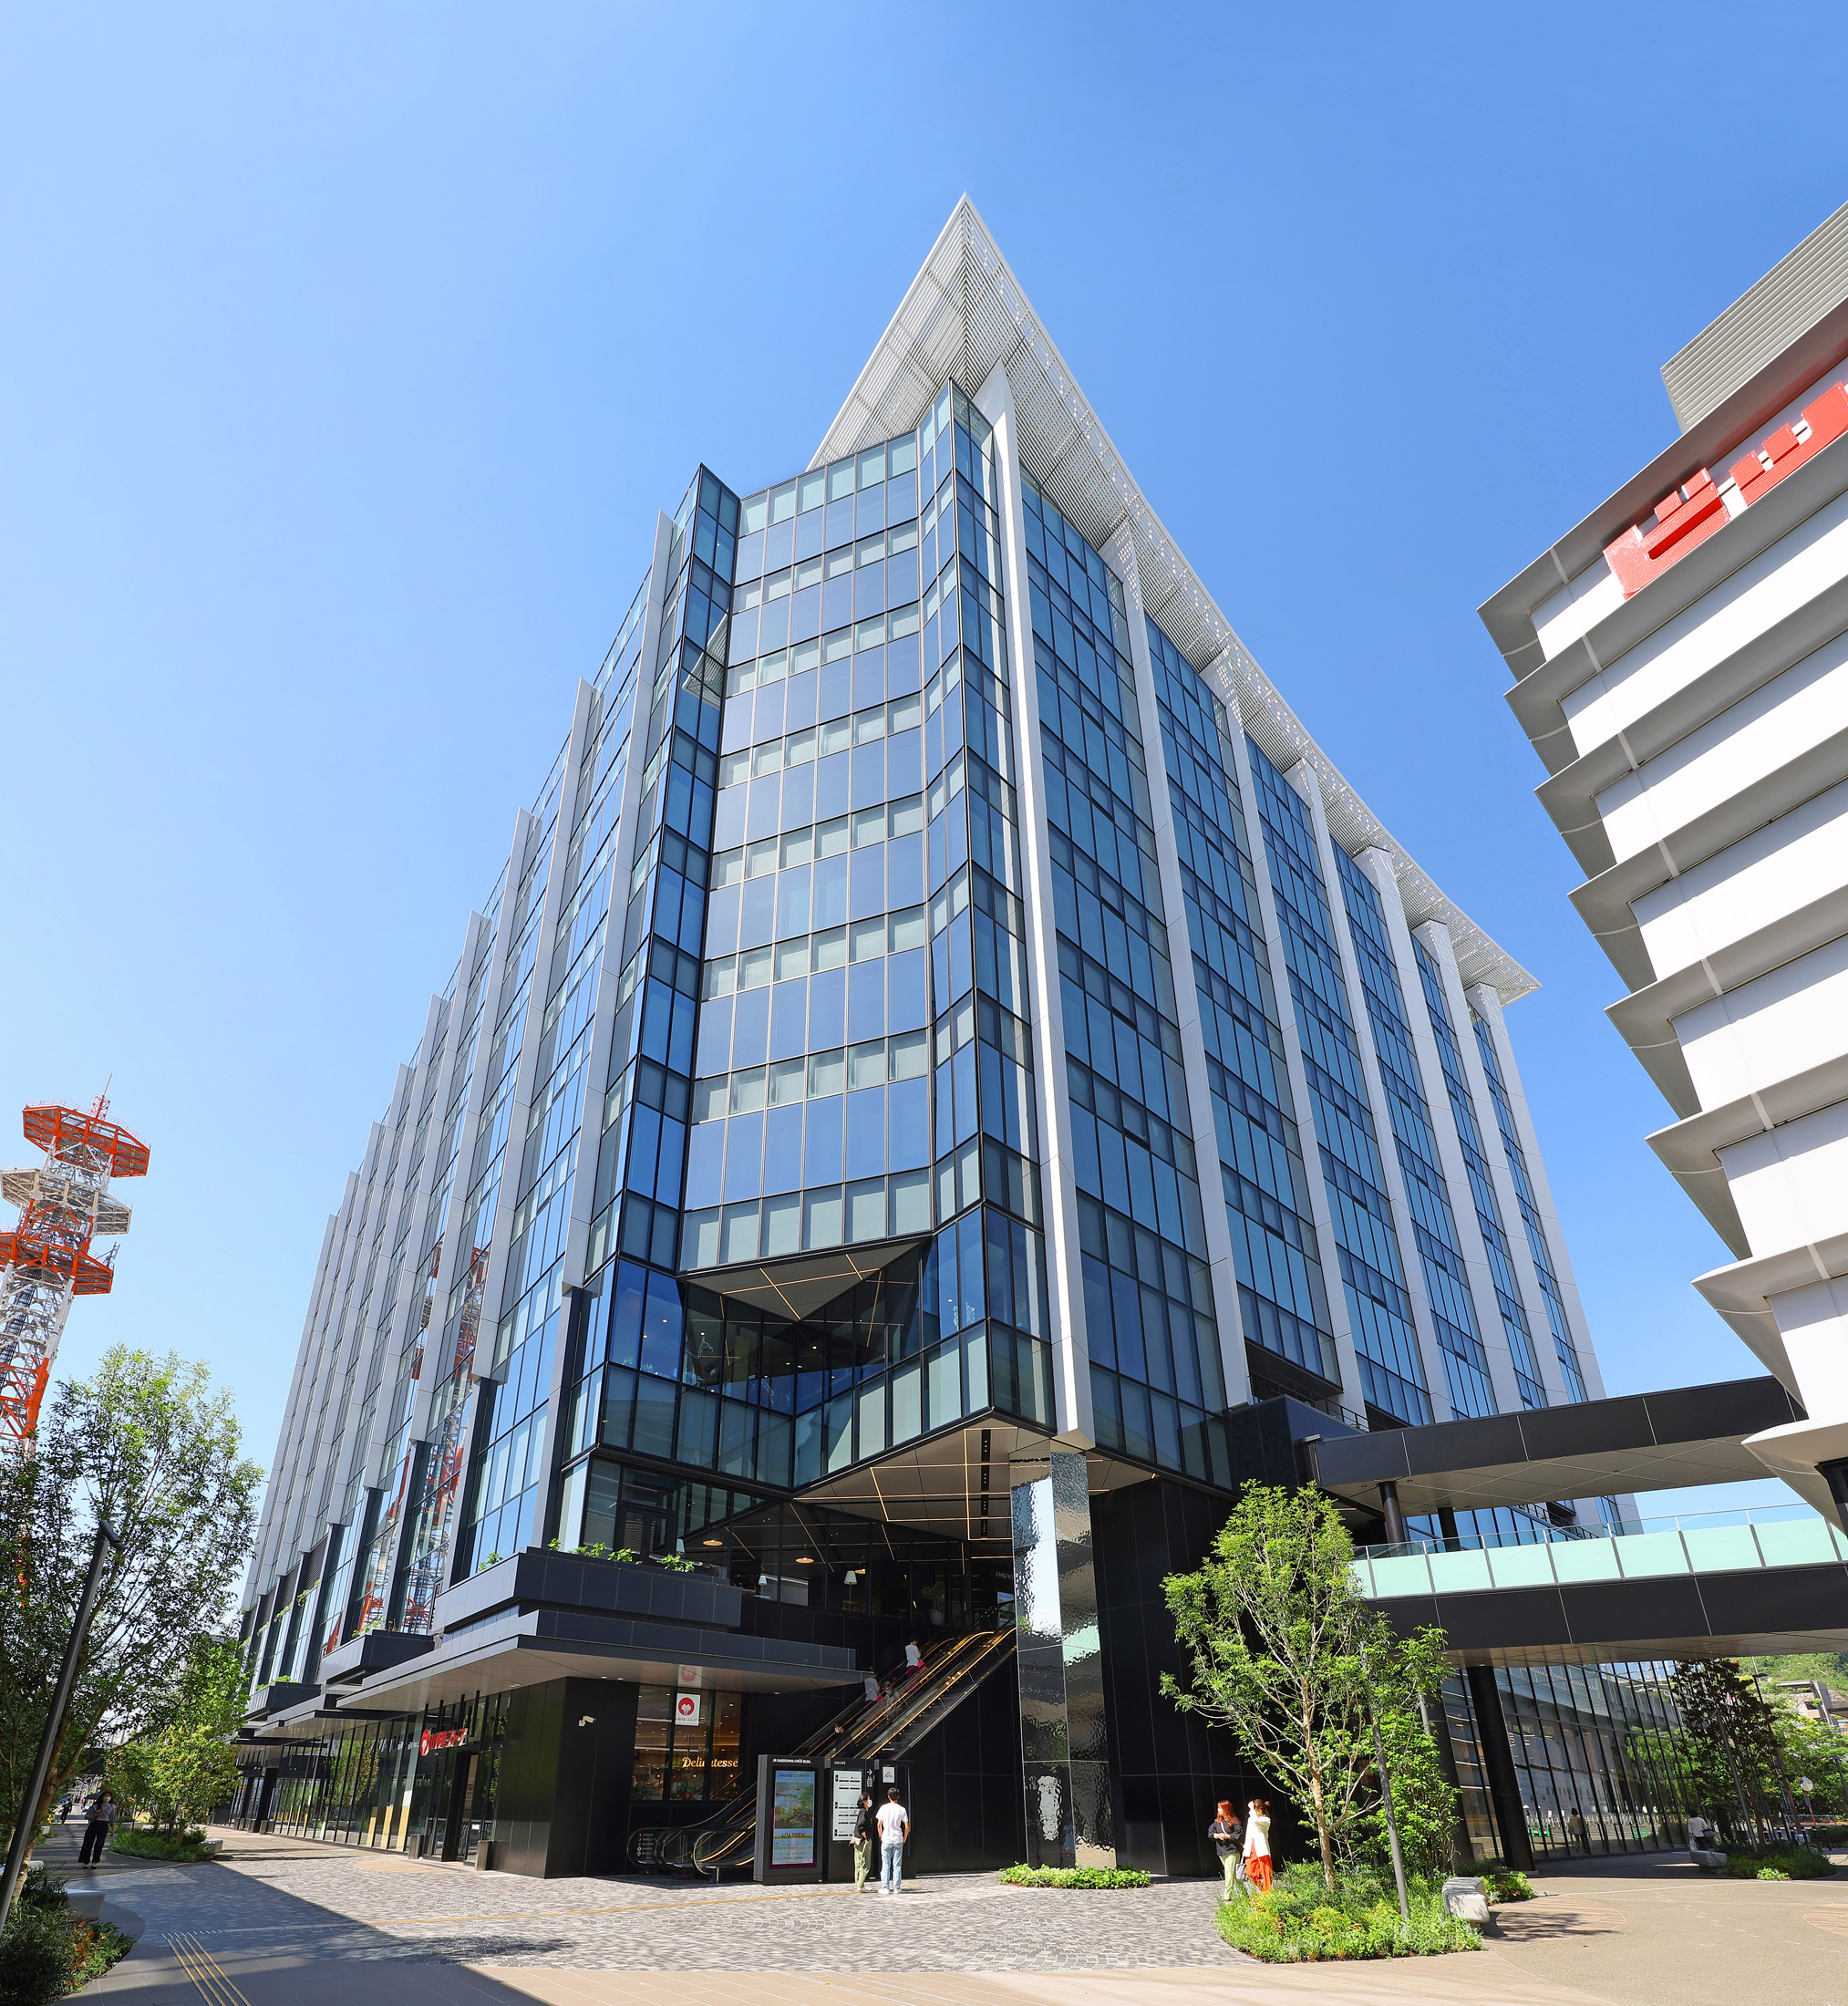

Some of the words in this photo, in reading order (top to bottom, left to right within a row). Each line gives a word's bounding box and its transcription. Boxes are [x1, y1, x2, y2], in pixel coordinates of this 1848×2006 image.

[428, 1728, 466, 1749] 山形屋ストア
